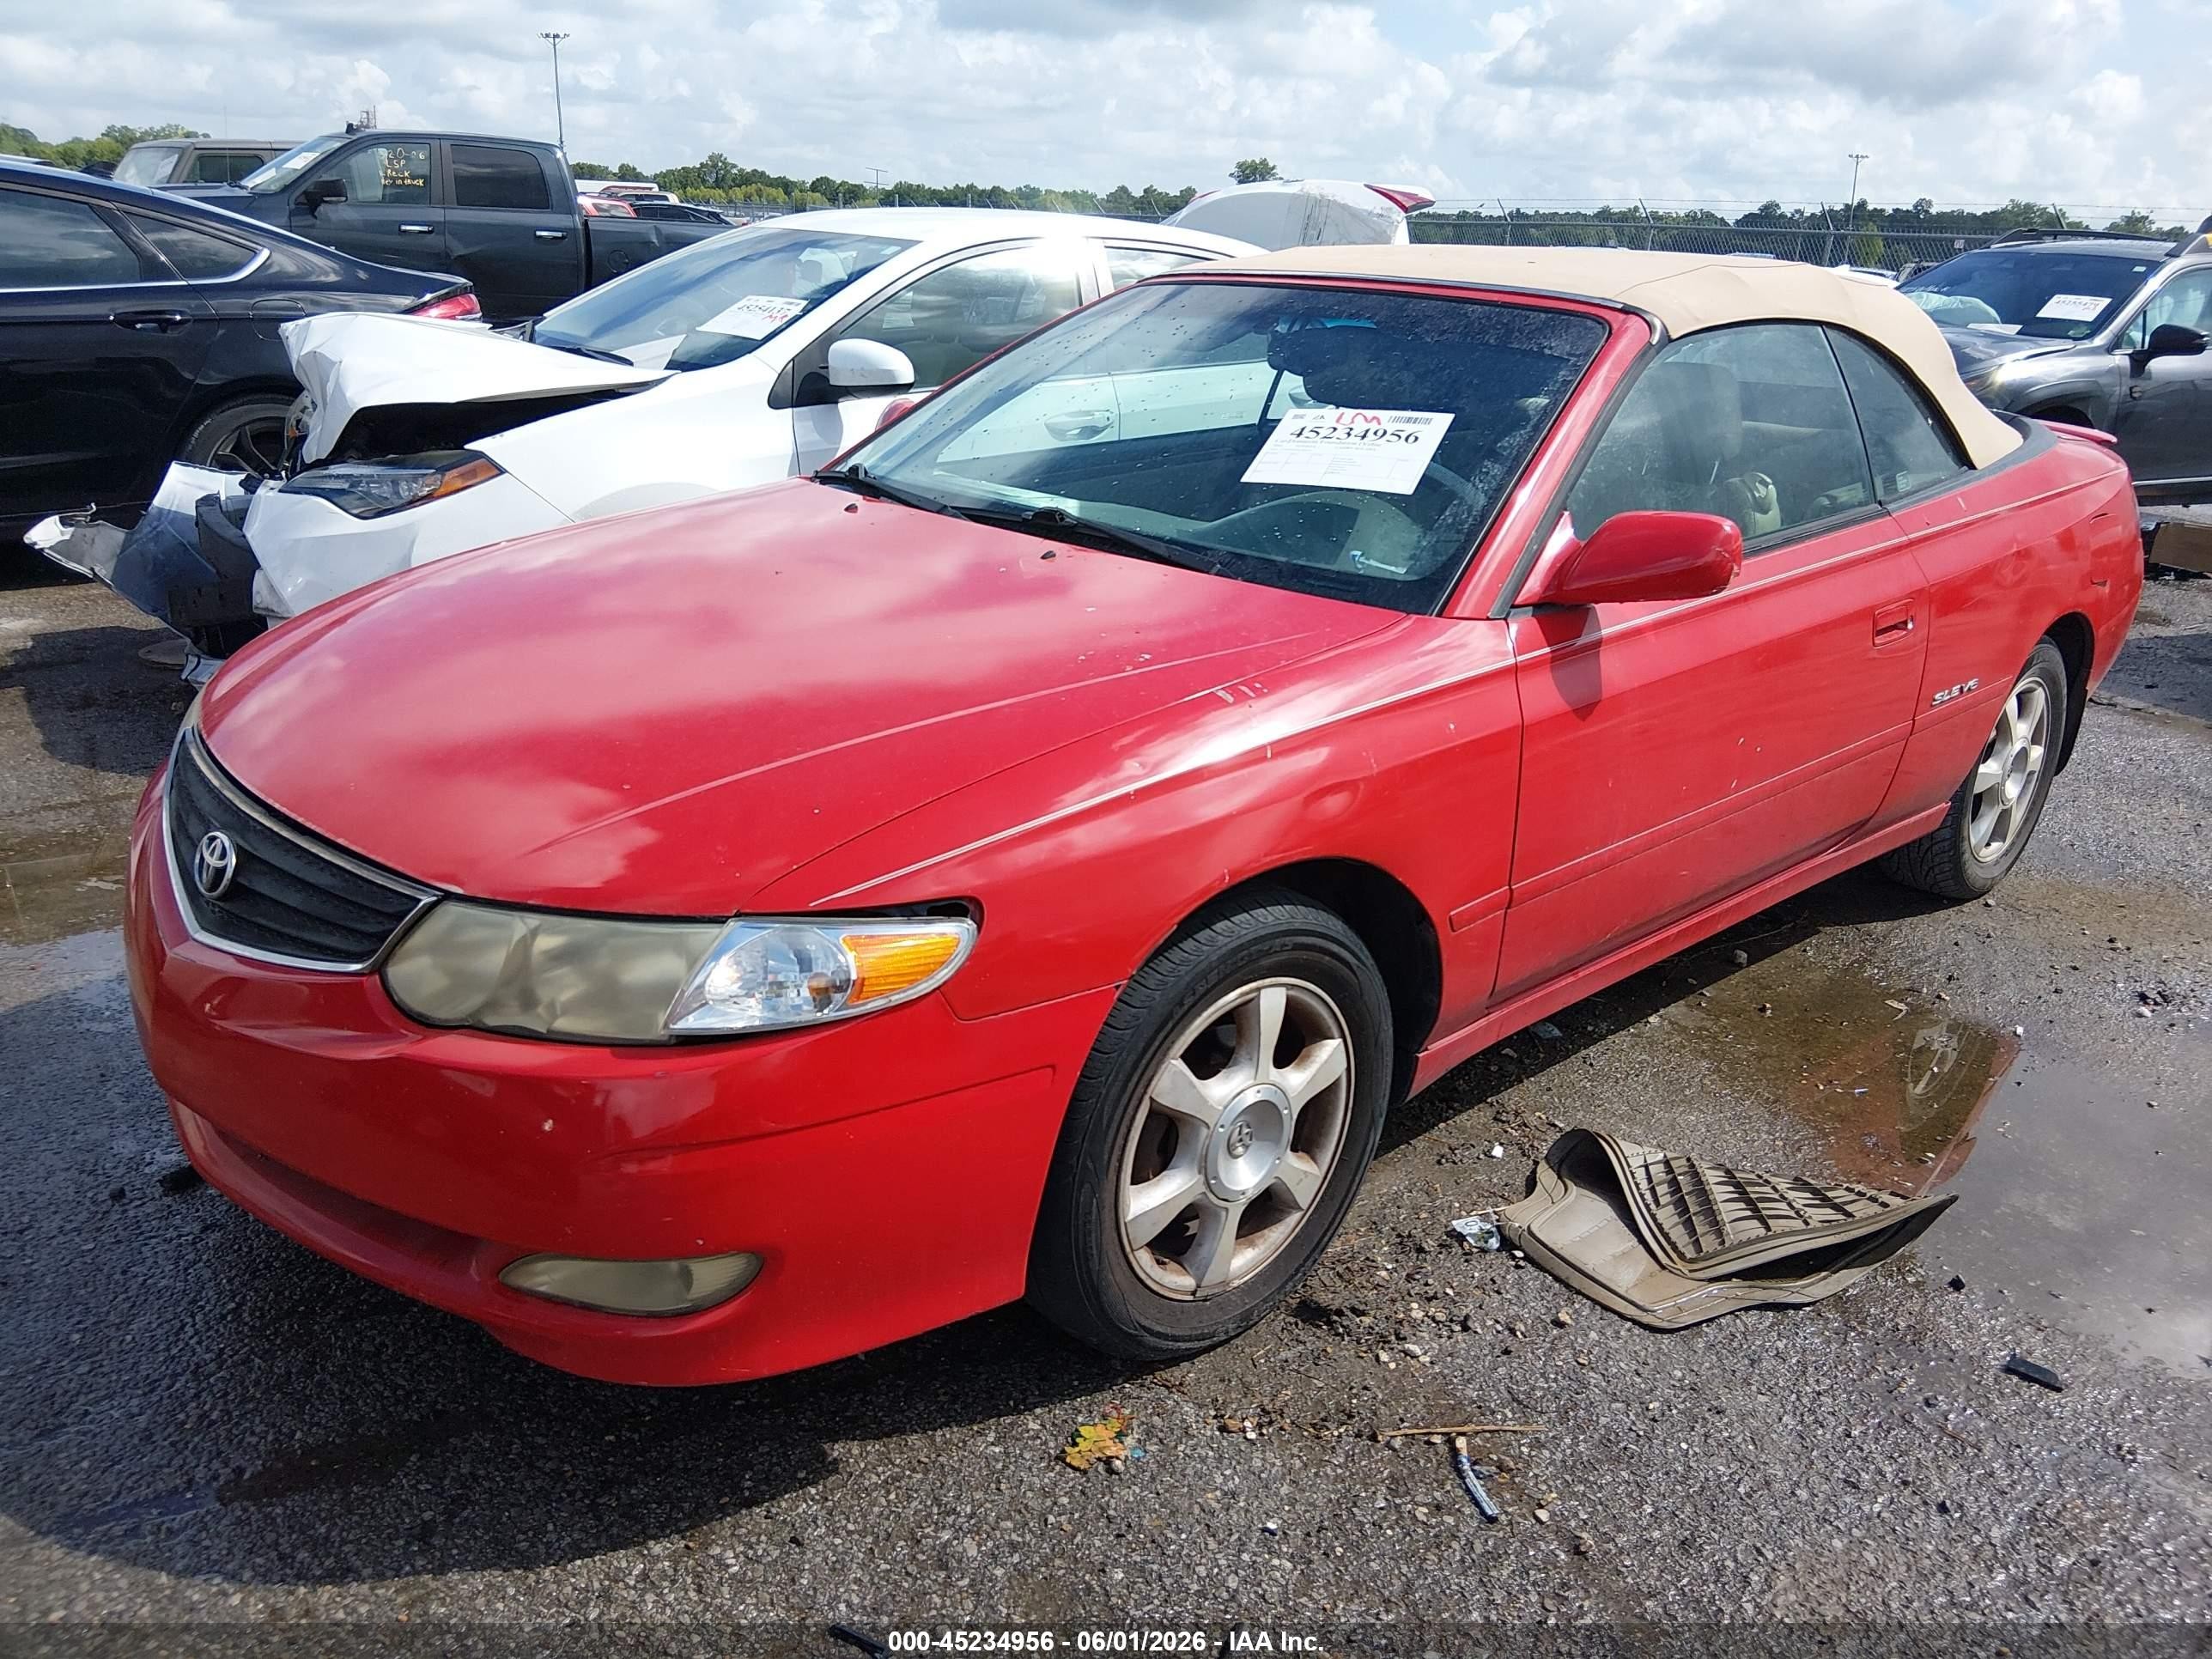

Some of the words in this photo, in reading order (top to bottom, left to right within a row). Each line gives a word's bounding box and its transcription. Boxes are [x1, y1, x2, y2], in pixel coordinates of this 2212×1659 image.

[1290, 424, 1424, 445] 45234956
[1931, 684, 1960, 706] SLE
[1960, 678, 1979, 693] V6
